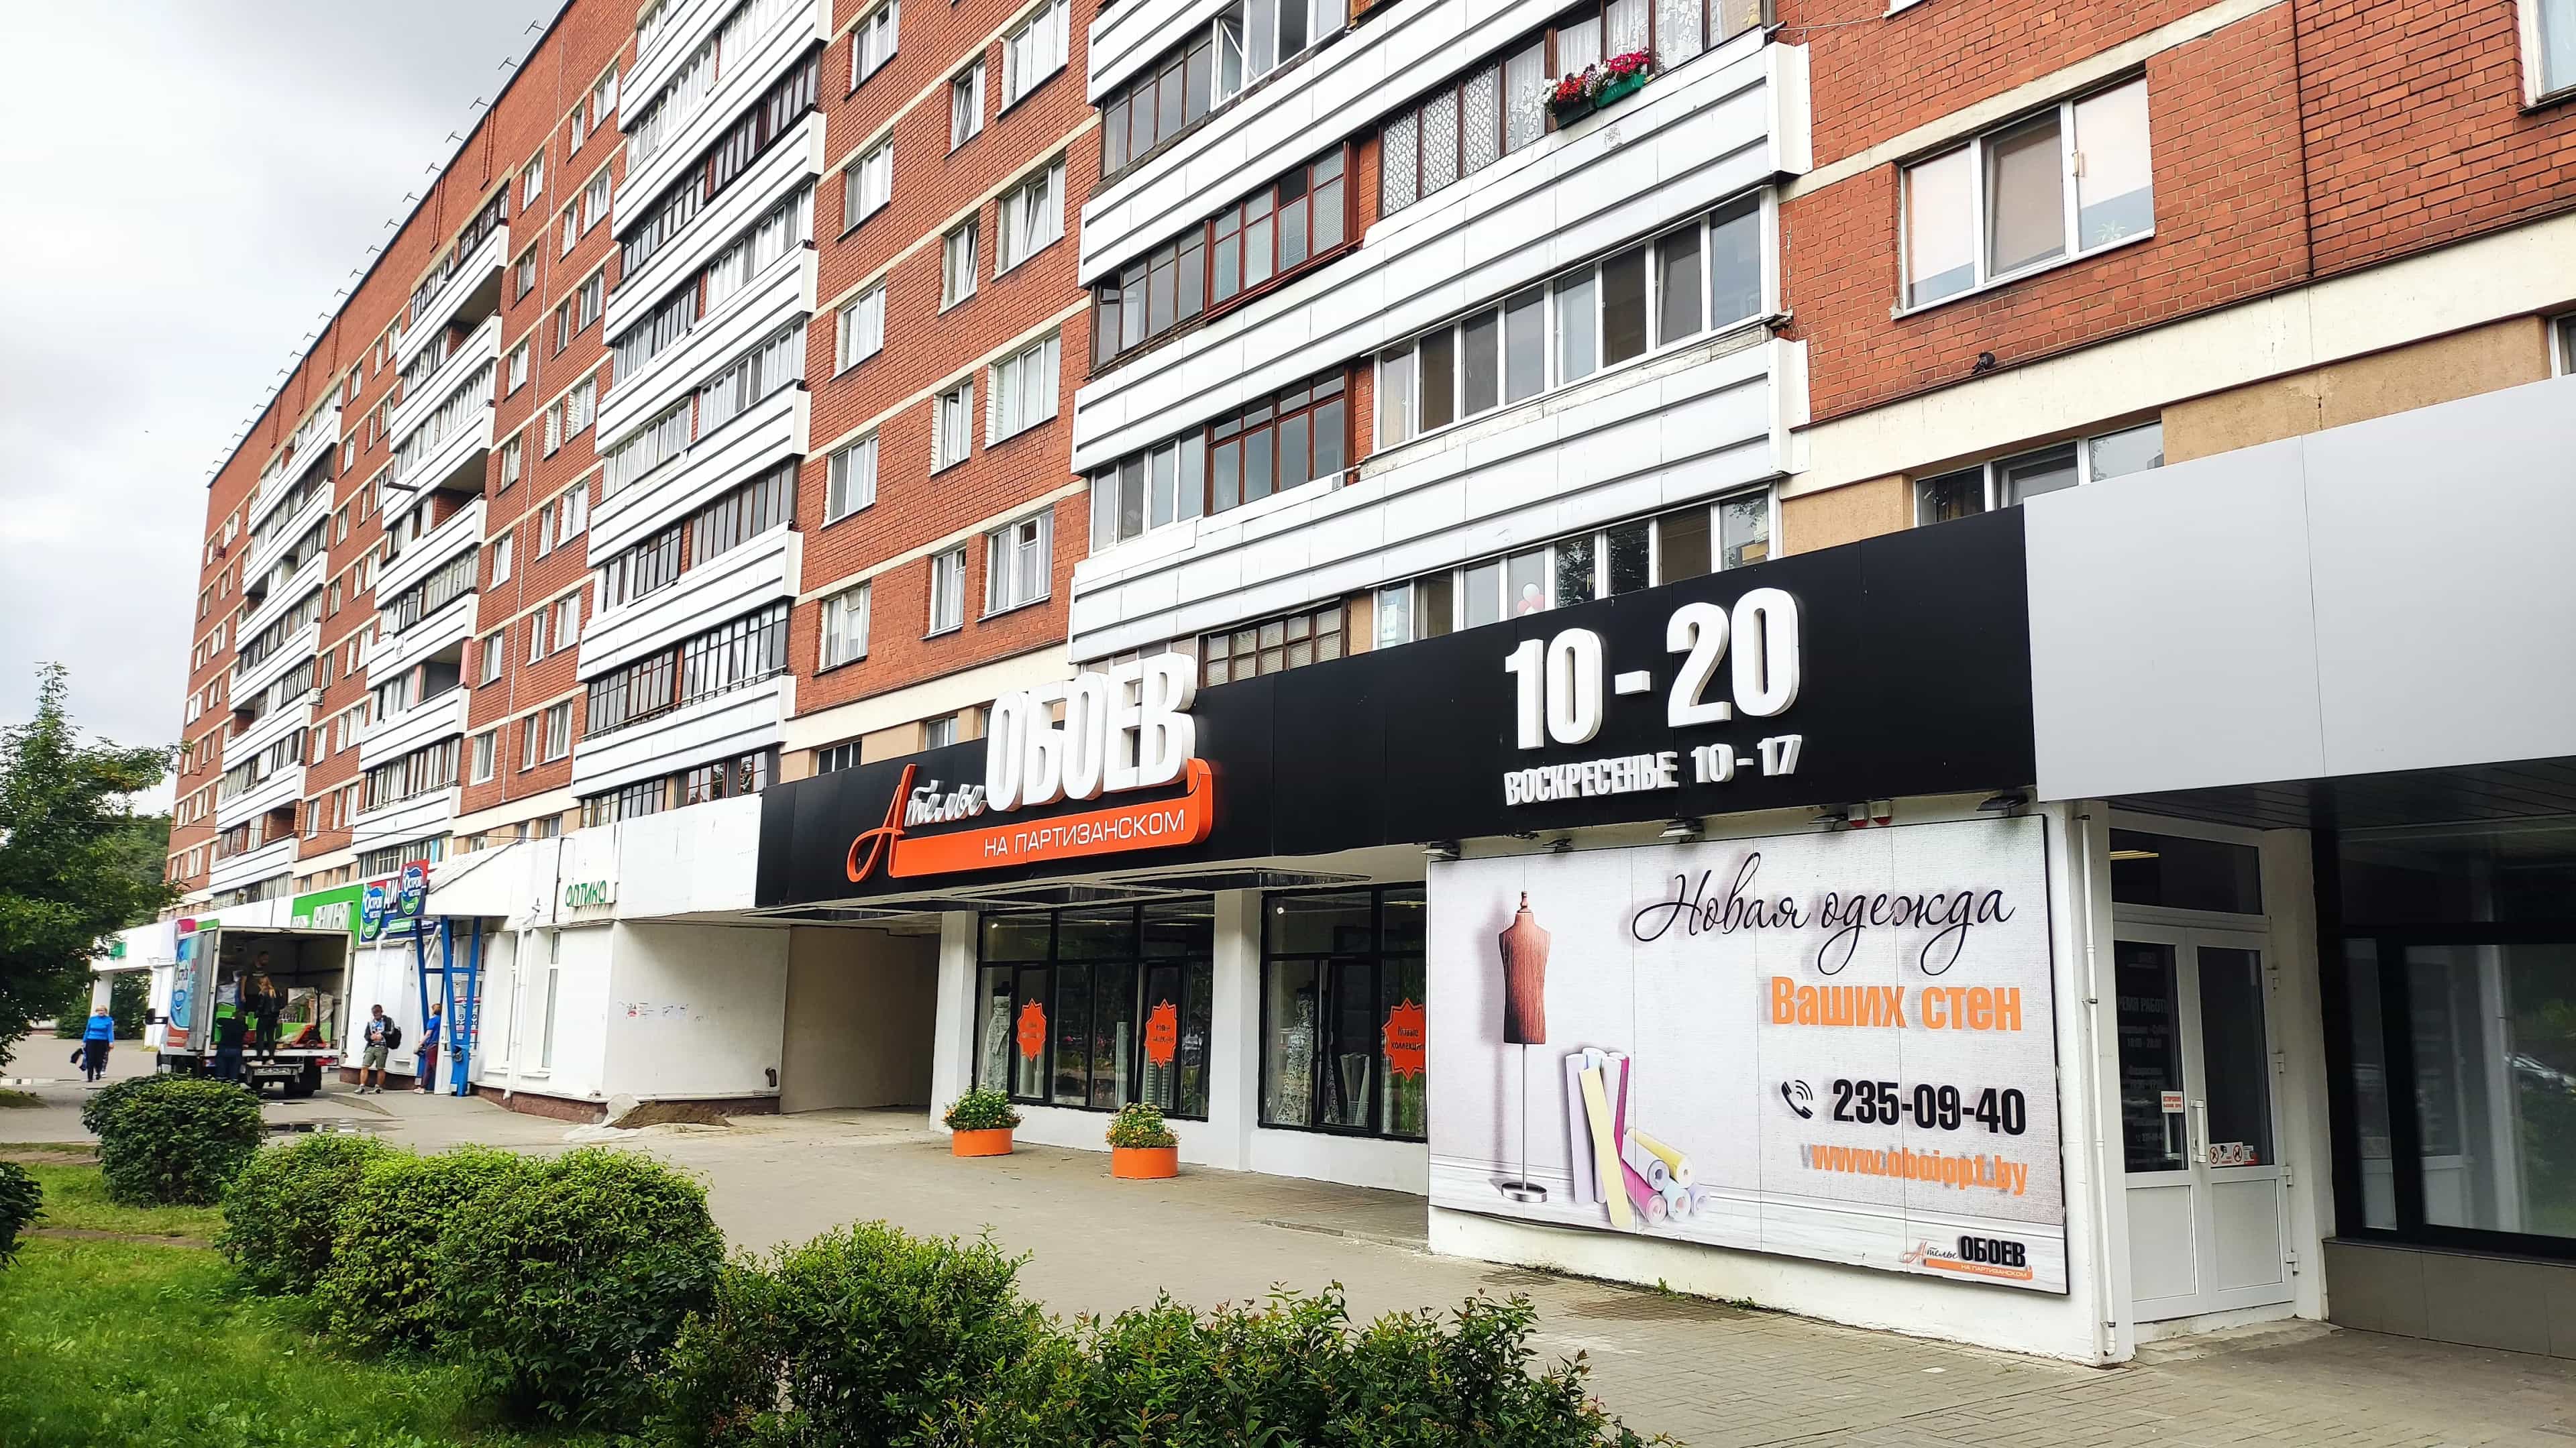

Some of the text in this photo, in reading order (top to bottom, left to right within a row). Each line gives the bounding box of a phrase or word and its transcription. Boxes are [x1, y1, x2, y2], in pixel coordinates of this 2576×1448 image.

[985, 652, 1197, 812] ОБОЕВ
[1503, 751, 1678, 805] ВОСКРЕСЕНЬЕ
[847, 763, 988, 883] Ателье
[984, 809, 1185, 858] НА ПАРТИЗАНСКОМ
[1632, 852, 2016, 976] Новая одежда
[1772, 977, 2022, 1032] Ваших стен
[1832, 1079, 2027, 1135] 235-09-40
[1960, 1235, 2026, 1268] ОБОЕВ
